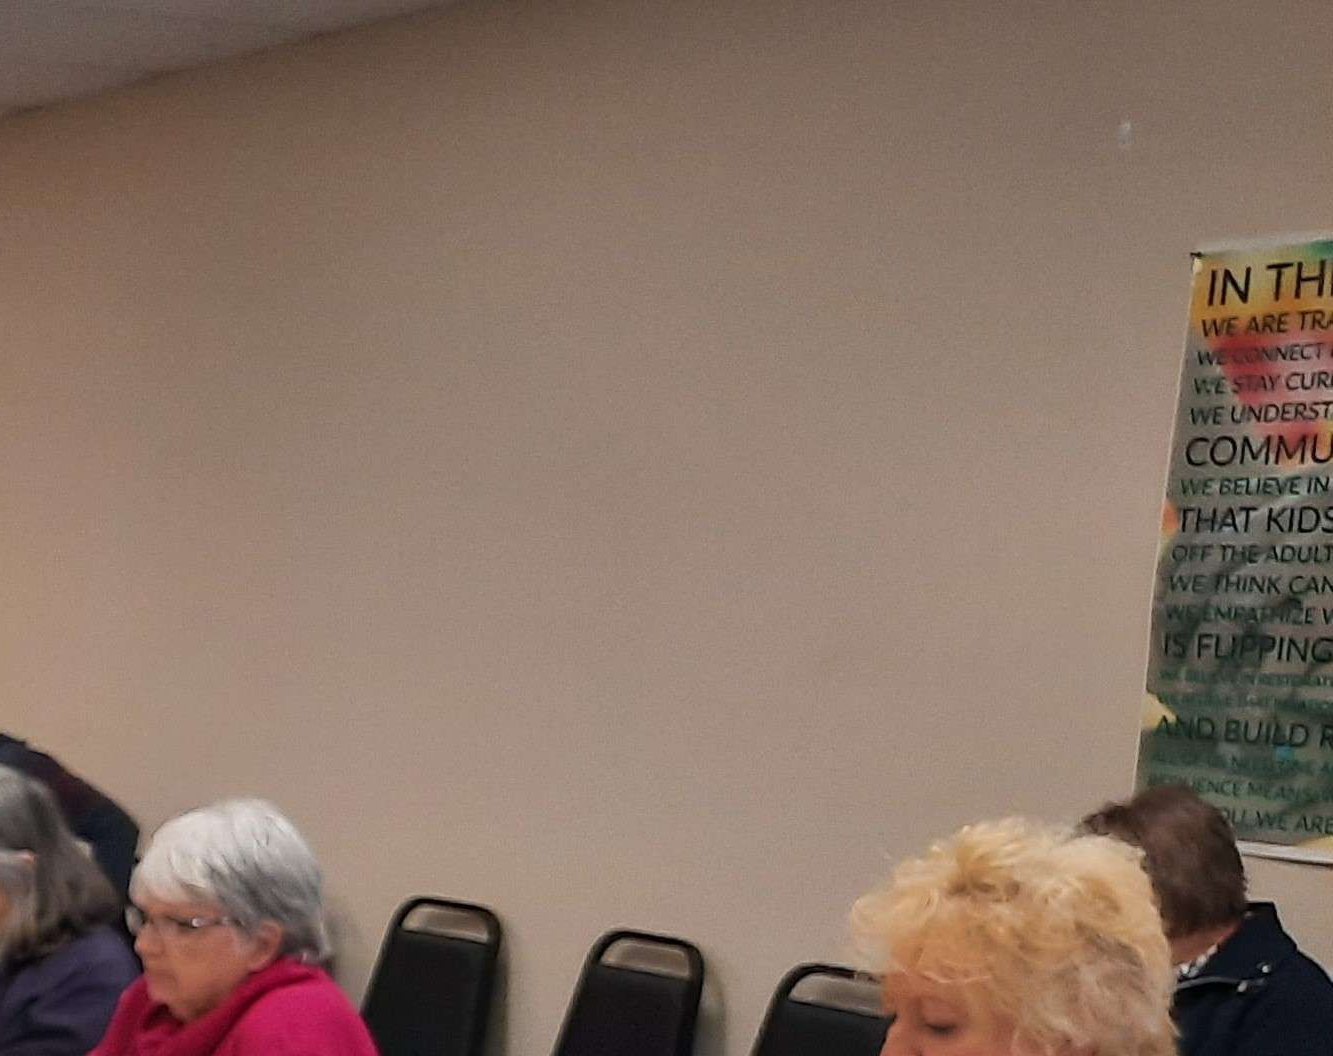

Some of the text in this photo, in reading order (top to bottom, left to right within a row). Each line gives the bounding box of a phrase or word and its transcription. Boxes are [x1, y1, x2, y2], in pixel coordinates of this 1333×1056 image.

[1207, 258, 1333, 306] IN TH
[1201, 316, 1238, 338] WE
[1246, 312, 1289, 334] ARE
[1196, 342, 1325, 366] WE CONNECT
[1193, 376, 1226, 395] WE
[1232, 374, 1281, 394] STAY
[1189, 405, 1225, 425] WE
[1185, 433, 1333, 468] COMMU
[1180, 475, 1331, 496] WE BELIEVE IN
[1179, 506, 1333, 534] THAT KIDS
[1171, 544, 1333, 564] OFF THE ADULT
[1168, 574, 1207, 593] WE
[1212, 574, 1282, 595] THINK
[1163, 633, 1333, 664] IS FLIPPING
[1155, 715, 1216, 741] AND
[1223, 719, 1311, 748] BUILD
